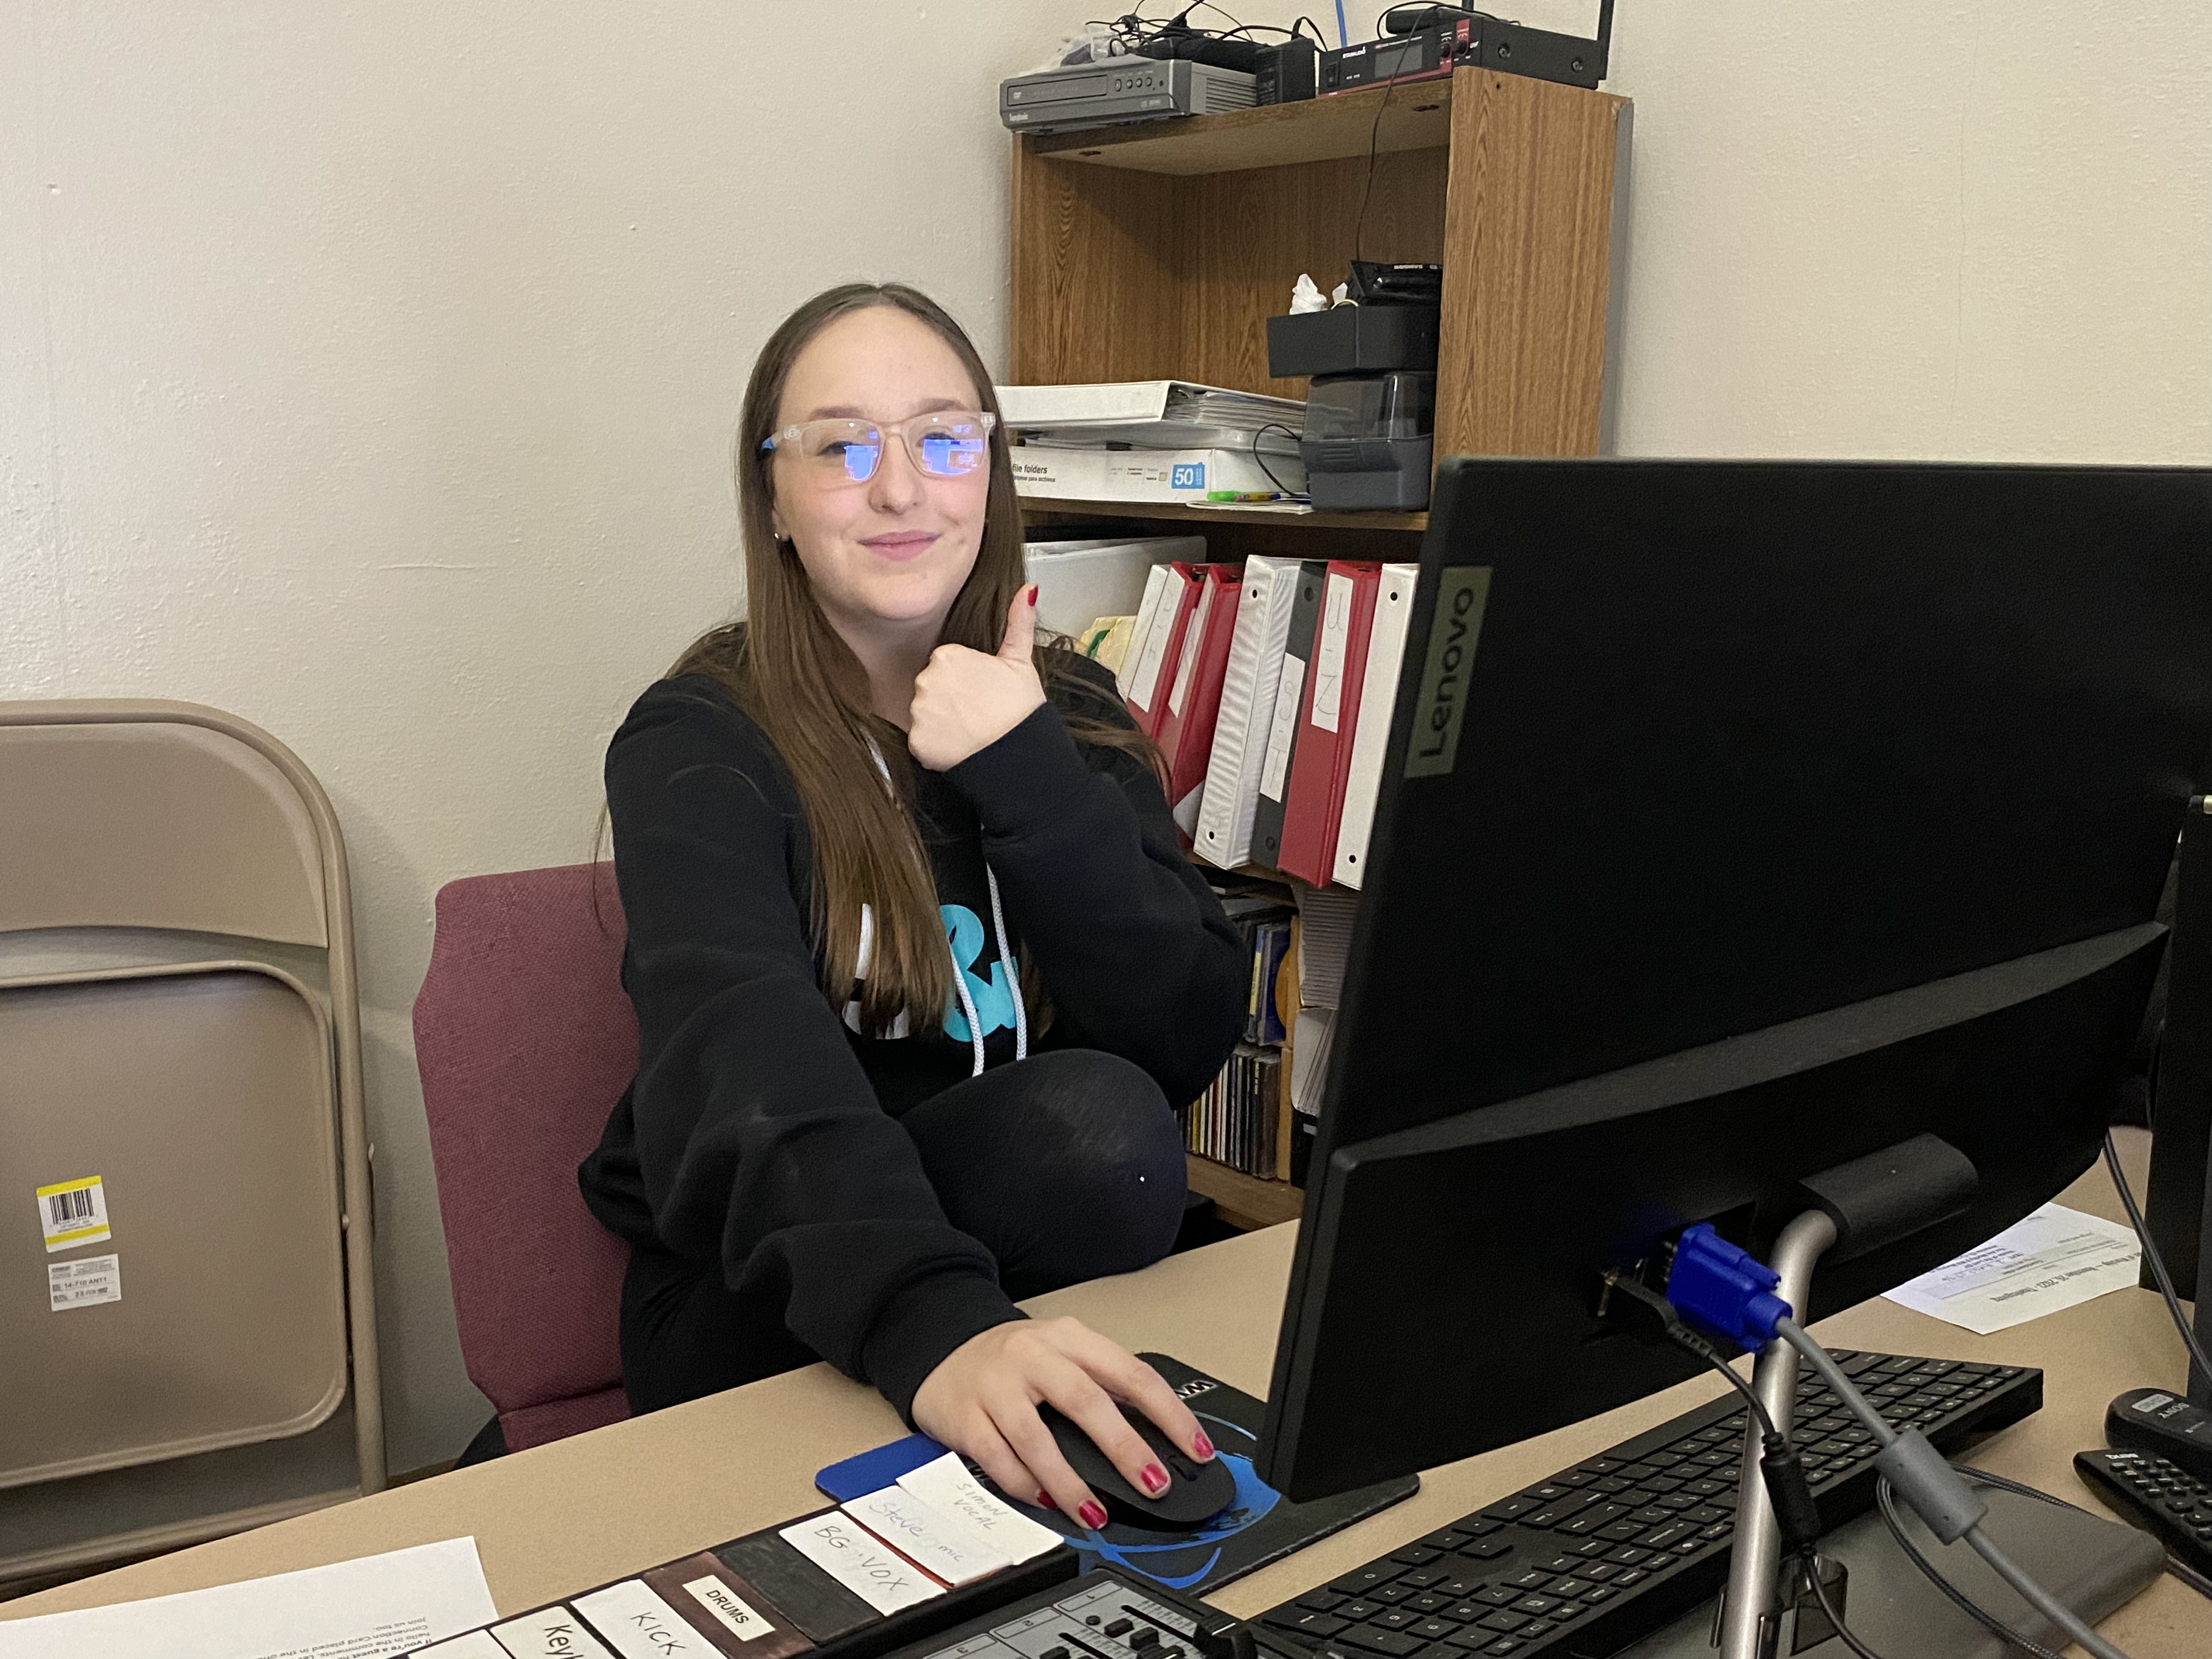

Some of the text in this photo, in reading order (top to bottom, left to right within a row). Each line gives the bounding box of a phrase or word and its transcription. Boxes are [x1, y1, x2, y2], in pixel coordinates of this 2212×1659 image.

[1024, 464, 1048, 473] folders
[1175, 468, 1194, 486] 50
[1419, 588, 1474, 757] Lenovo
[2158, 1402, 2190, 1419] SONY
[957, 1483, 1010, 1517] SIMON
[869, 1503, 924, 1537] Steve
[954, 1499, 997, 1530] VOCAL
[706, 1589, 749, 1624] DRUMS
[347, 1636, 372, 1645] Card
[373, 1625, 428, 1639] Connection
[406, 1632, 430, 1640] hello
[630, 1611, 686, 1656] KICK
[312, 1640, 345, 1652] placed
[352, 1648, 380, 1658] guest
